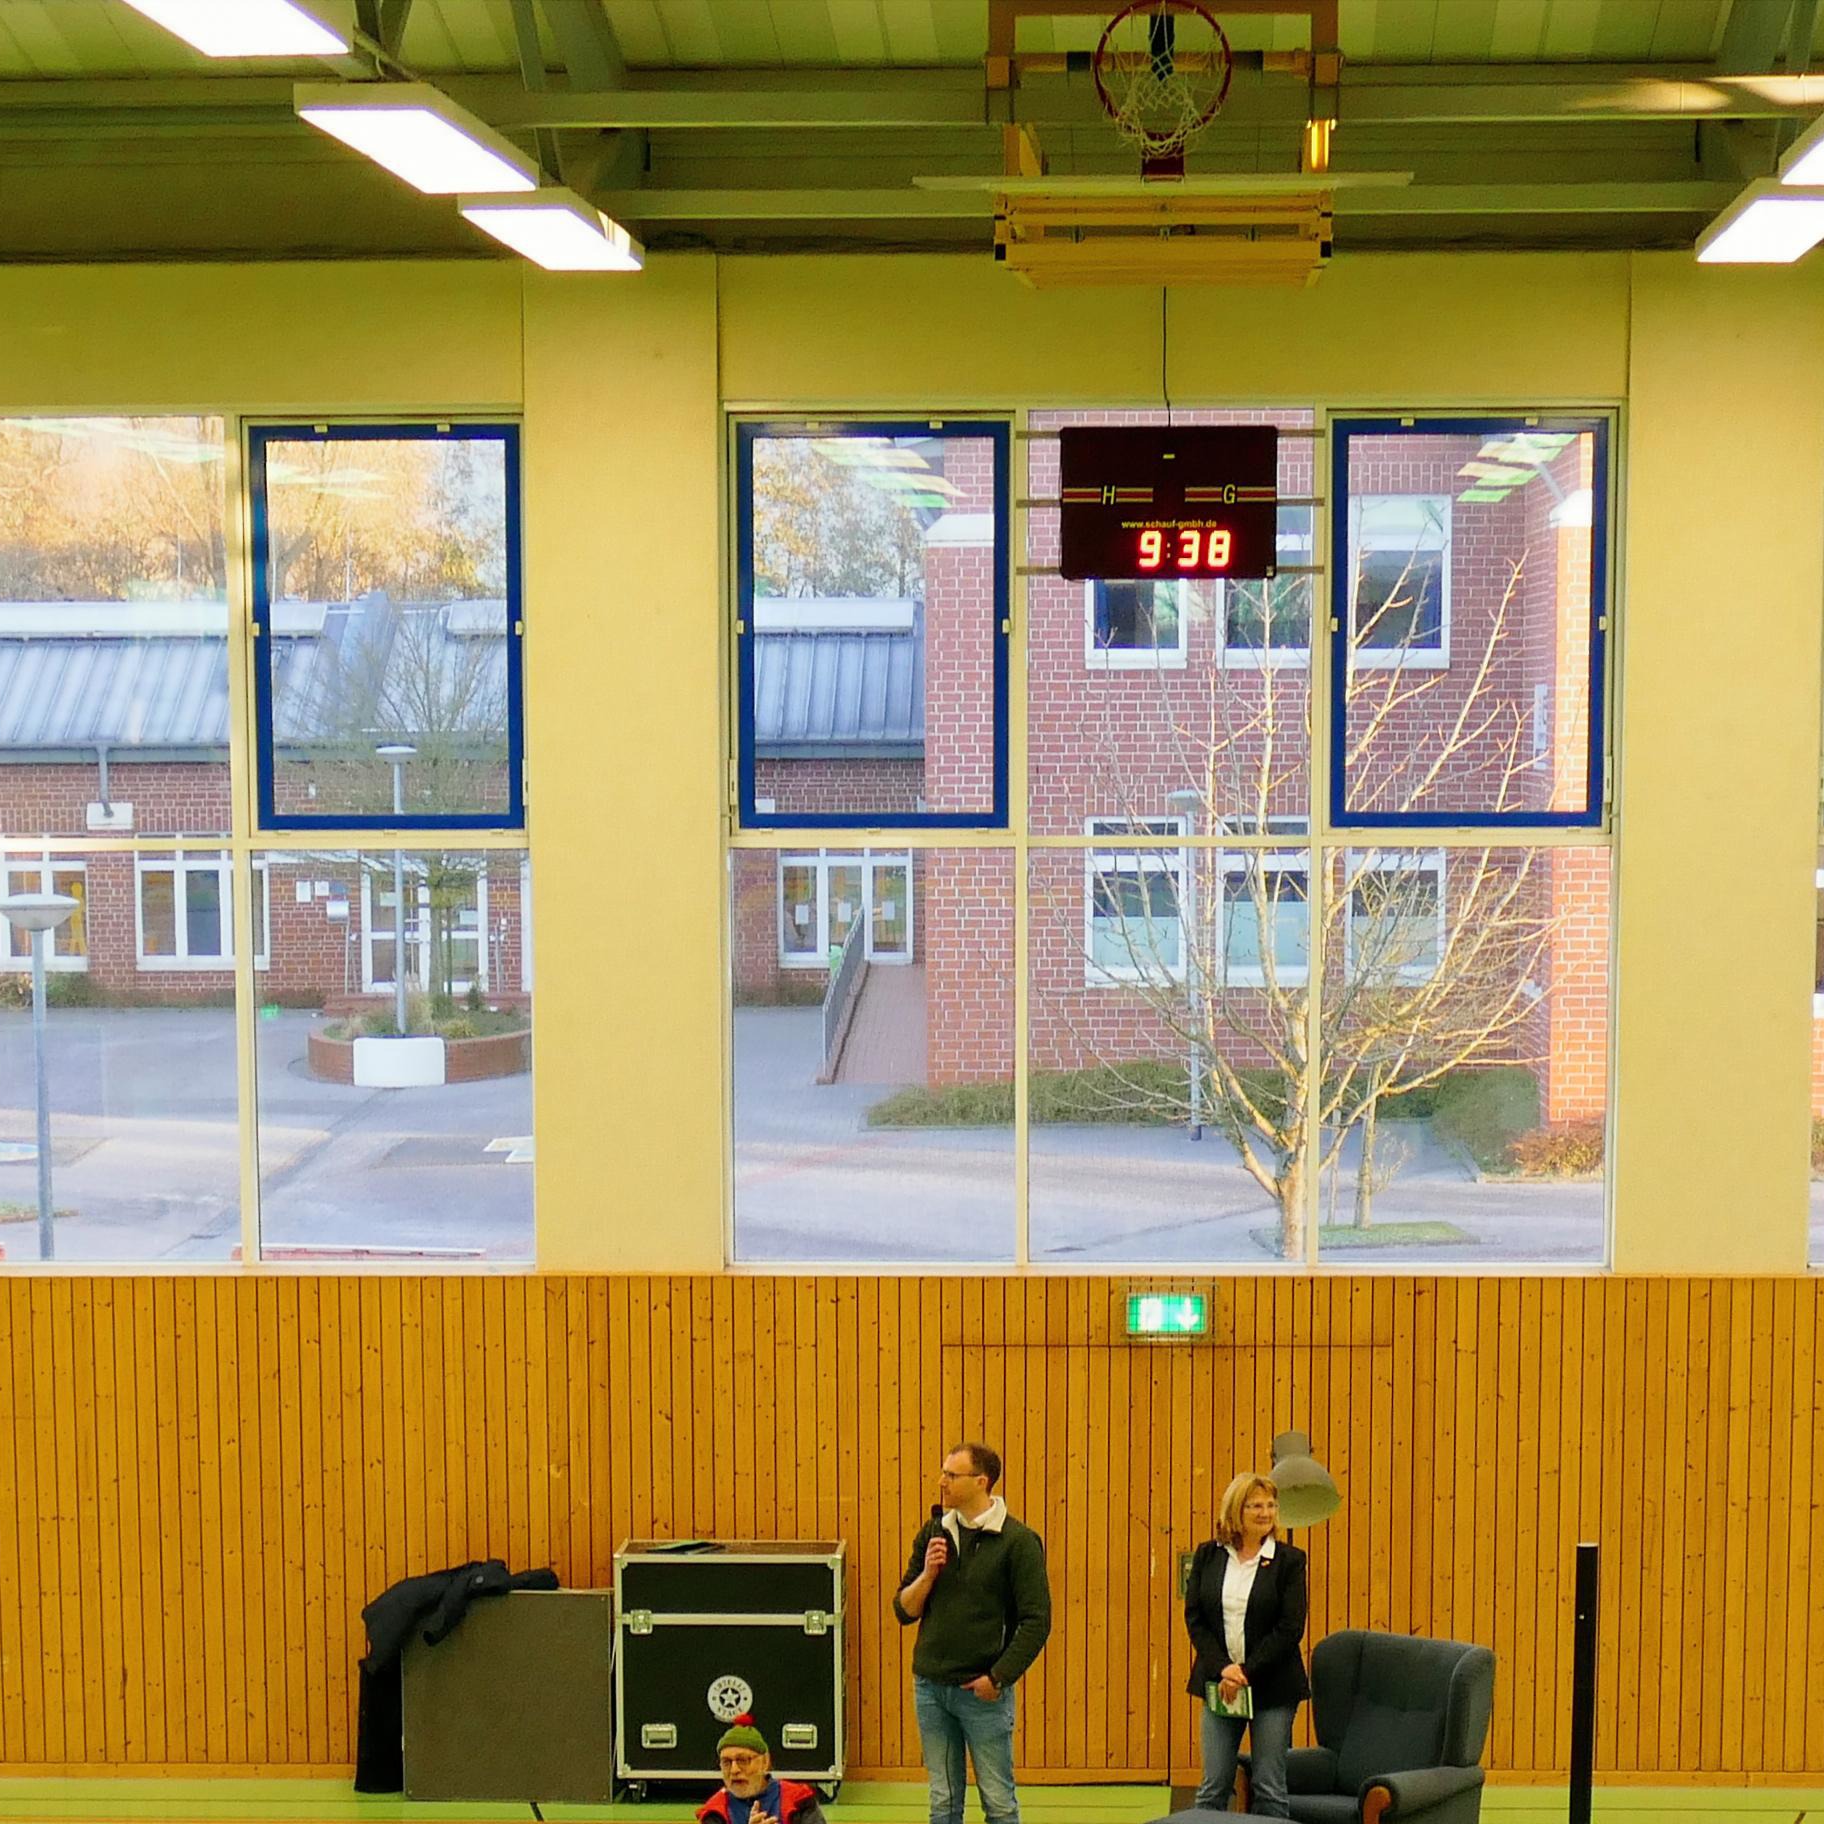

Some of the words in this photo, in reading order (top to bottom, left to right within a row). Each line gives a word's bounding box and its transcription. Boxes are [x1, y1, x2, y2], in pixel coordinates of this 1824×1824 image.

[1102, 485, 1116, 505] H
[1223, 484, 1236, 504] G
[1121, 519, 1217, 529] www.schauf-gmbh.de
[1138, 530, 1232, 567] 9:38
